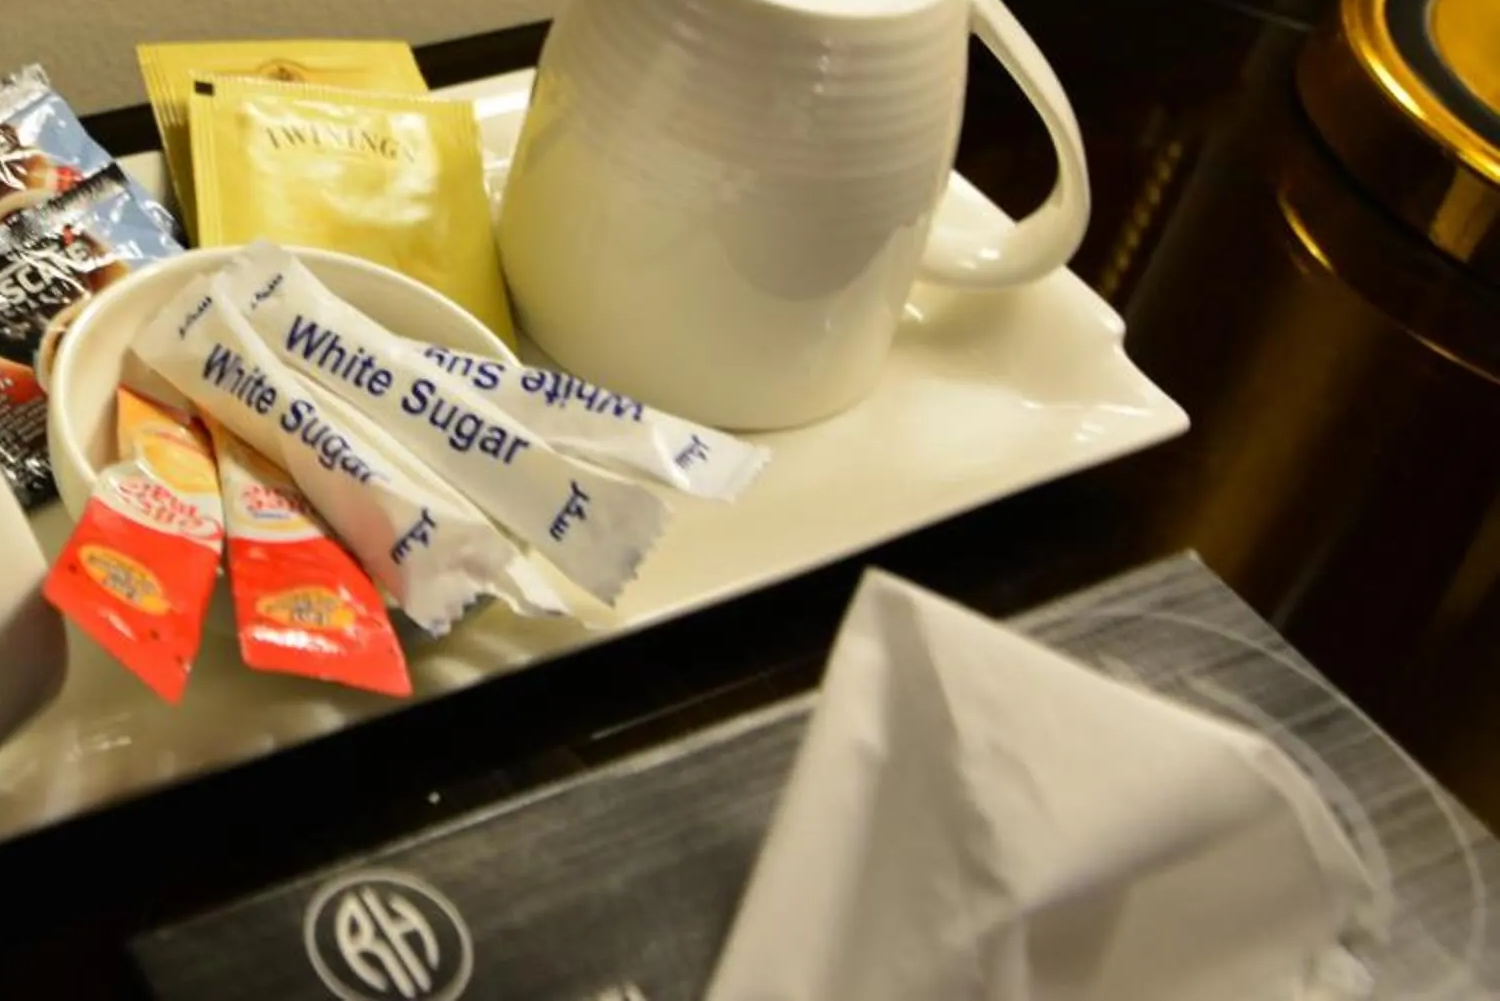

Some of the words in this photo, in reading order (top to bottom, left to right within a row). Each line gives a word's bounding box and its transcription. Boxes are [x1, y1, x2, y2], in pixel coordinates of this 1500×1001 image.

[202, 344, 277, 415] White
[280, 399, 385, 484] Sugar
[285, 315, 393, 397] White
[401, 378, 530, 465] Sugar
[520, 369, 645, 423] White
[334, 885, 441, 1000] RH
